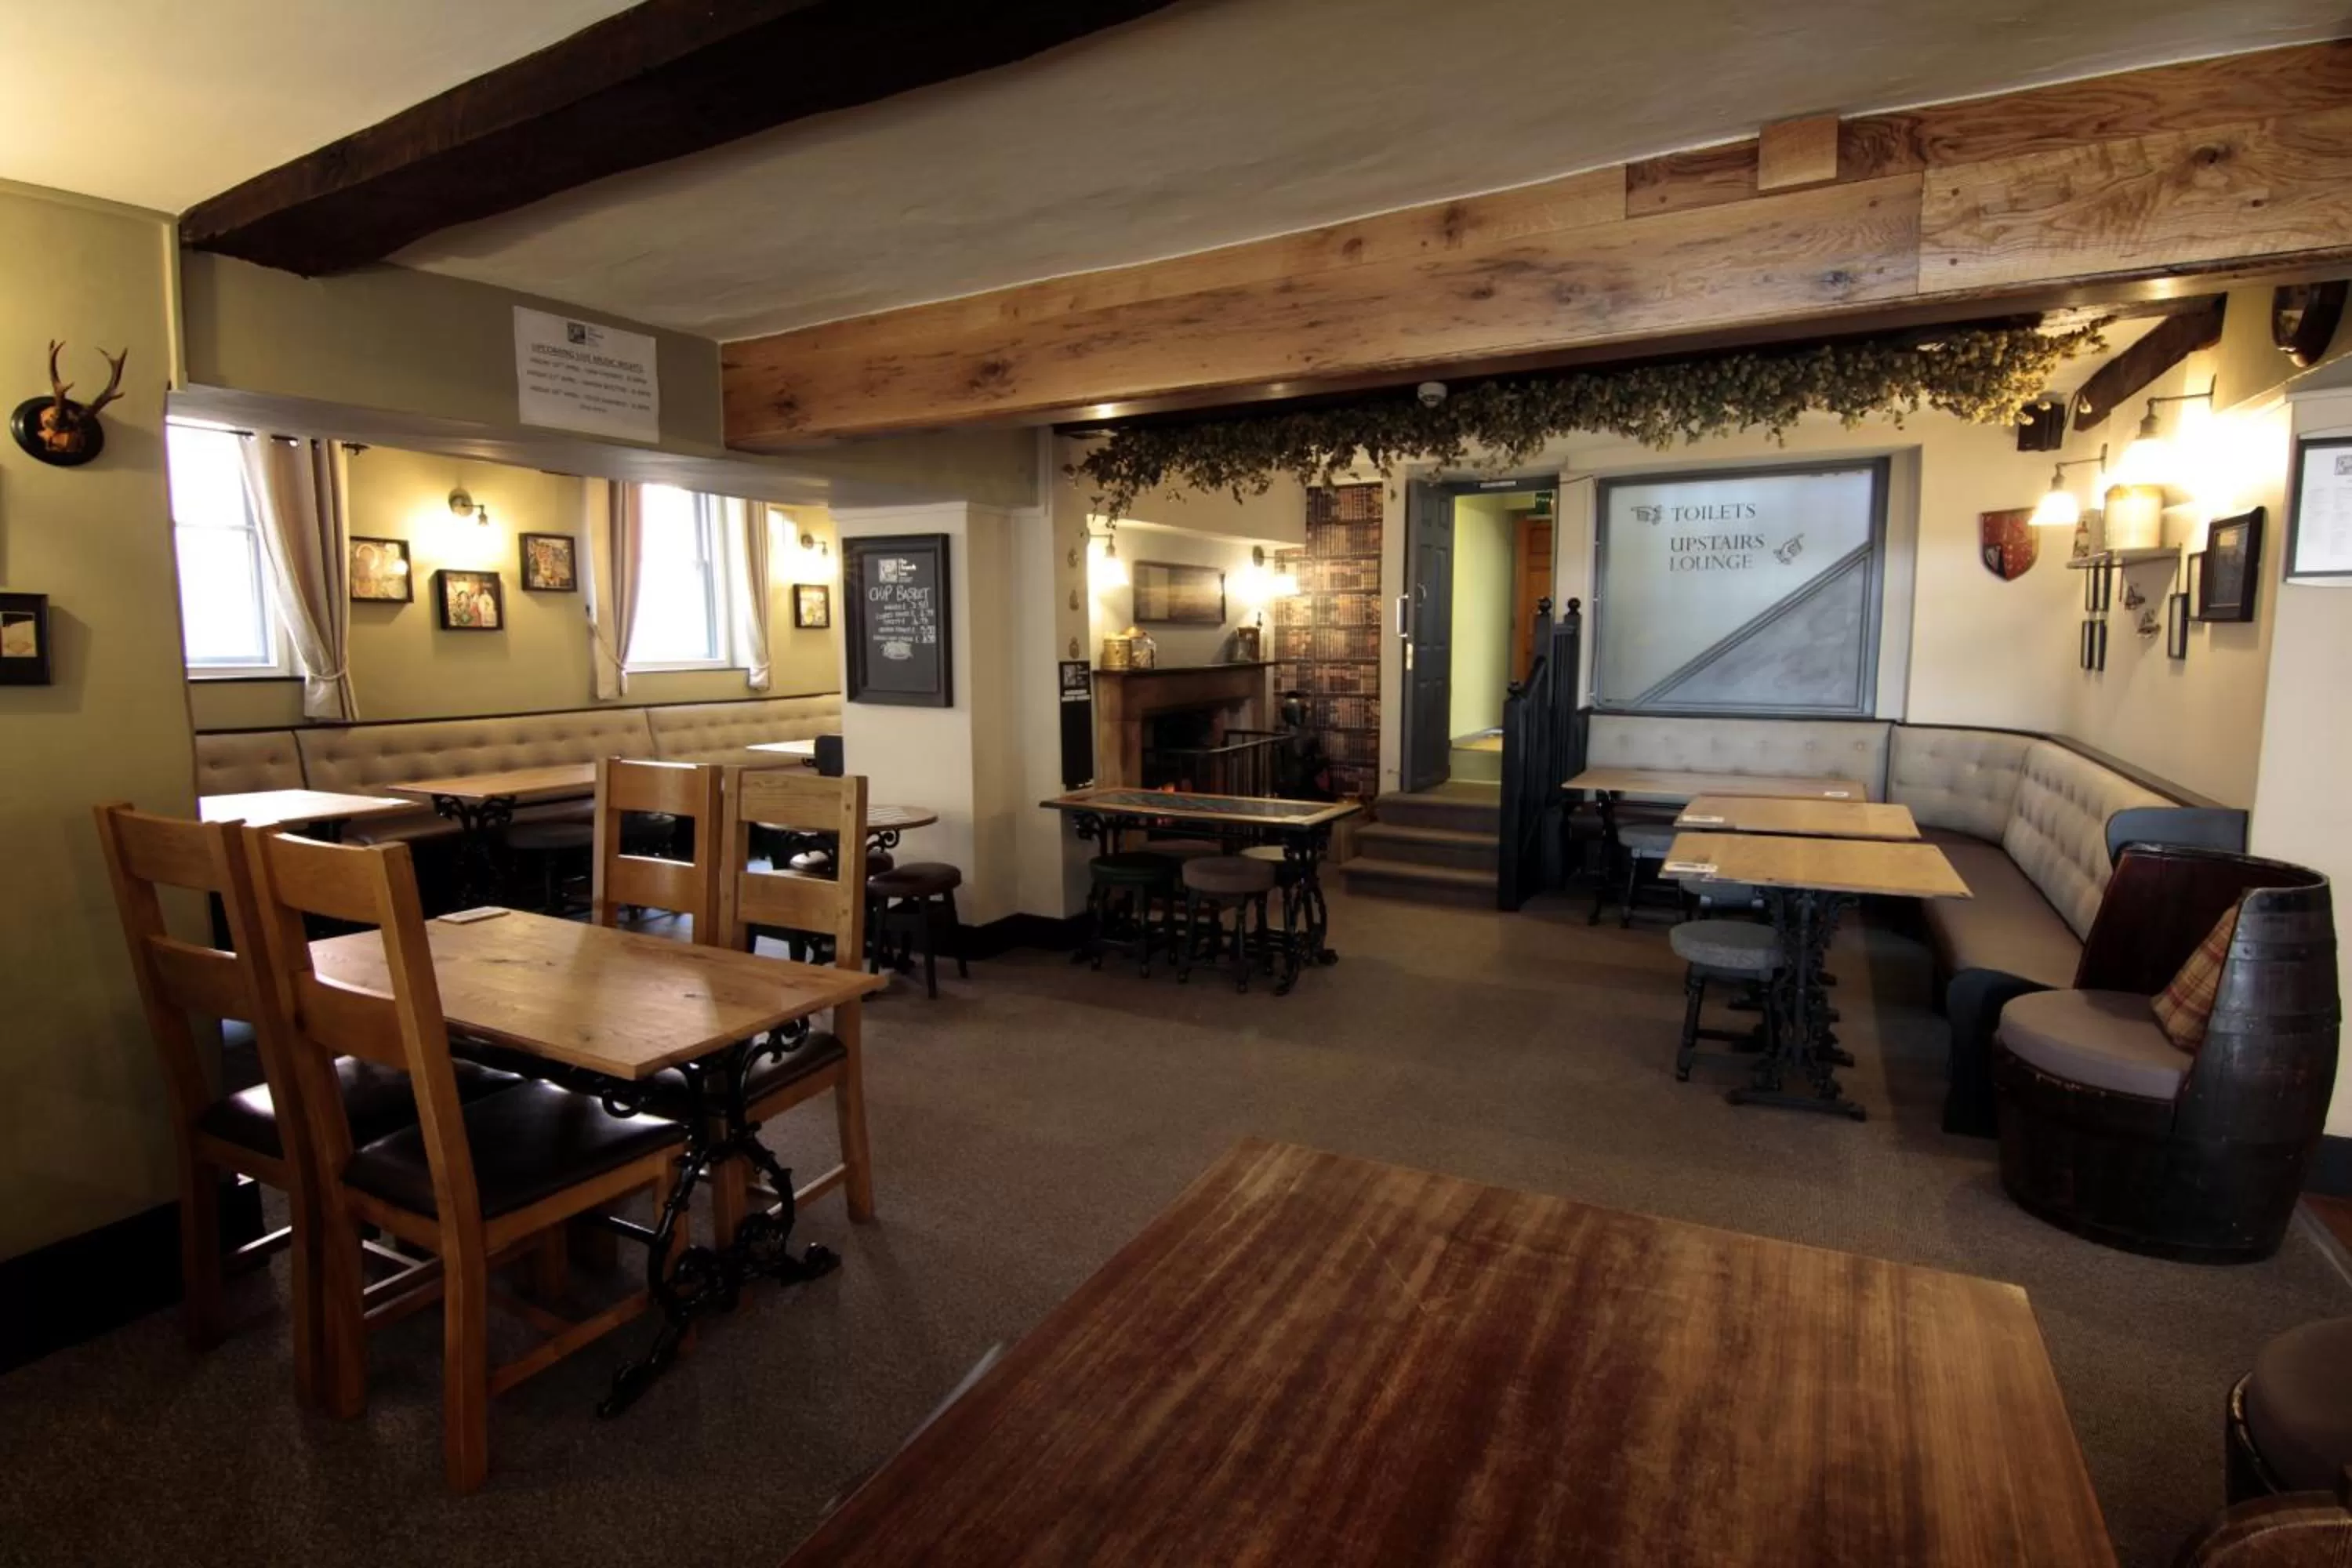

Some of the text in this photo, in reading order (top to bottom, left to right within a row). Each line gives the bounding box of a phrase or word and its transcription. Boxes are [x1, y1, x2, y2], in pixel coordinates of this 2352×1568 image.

[1671, 503, 1756, 522] TOILETS
[1670, 533, 1765, 552] UPSTAIRS
[1669, 554, 1754, 572] LOUNGE
